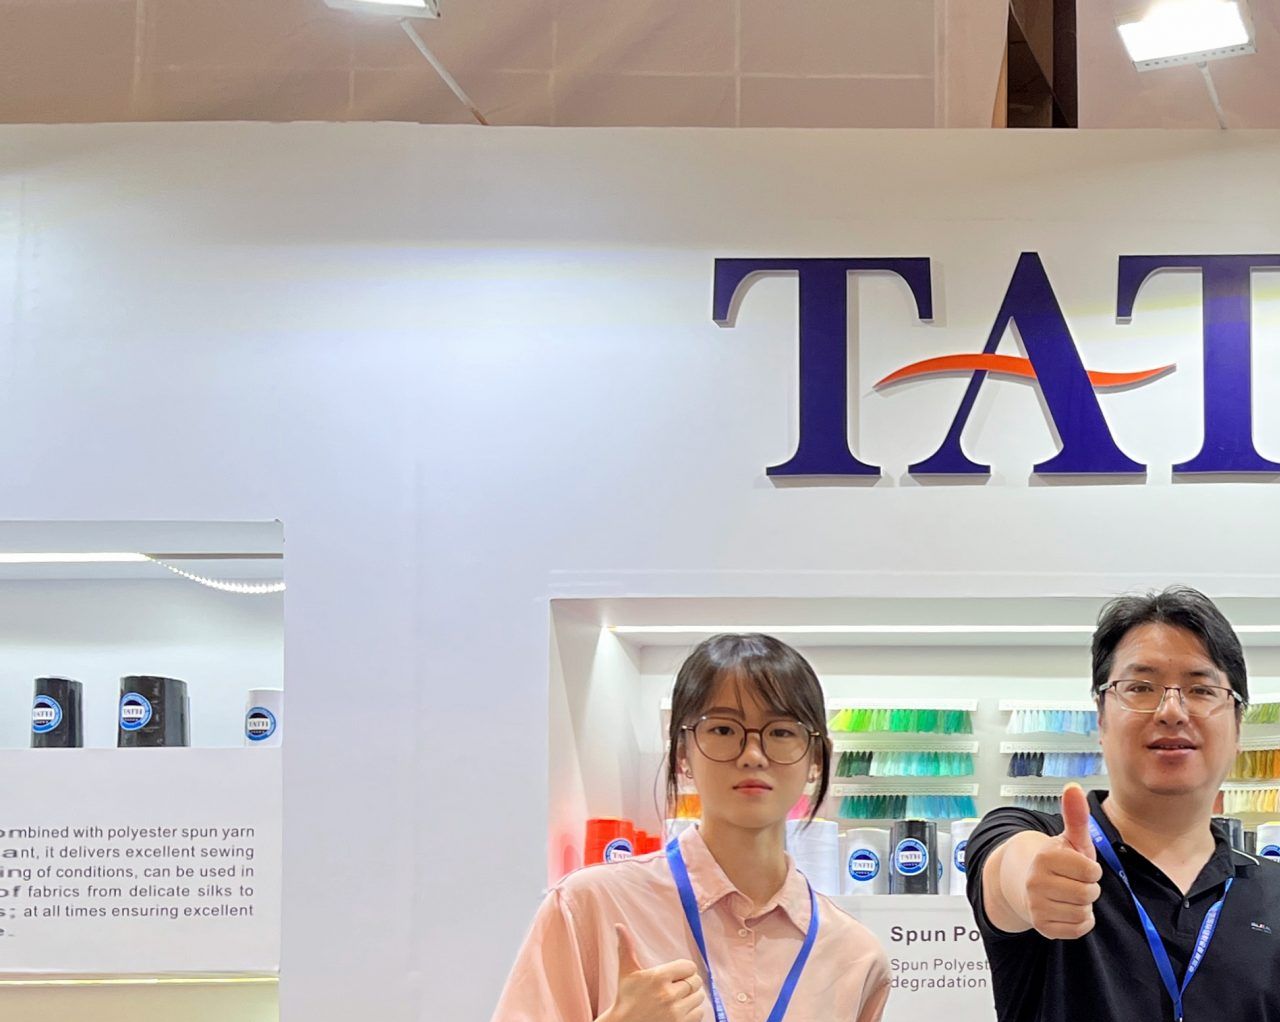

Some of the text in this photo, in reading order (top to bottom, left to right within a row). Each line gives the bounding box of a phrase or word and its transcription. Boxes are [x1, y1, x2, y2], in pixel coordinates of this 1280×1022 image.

[72, 825, 255, 841] with polyester spun yarn
[45, 844, 254, 861] it delivers excellent sewing
[36, 864, 254, 879] of conditions, can be used in
[27, 883, 254, 898] fabrics from delicate silks to
[23, 903, 253, 920] at all times ensuring excellent
[889, 925, 946, 946] Spun
[889, 957, 929, 974] Spun
[890, 974, 987, 992] degradation
